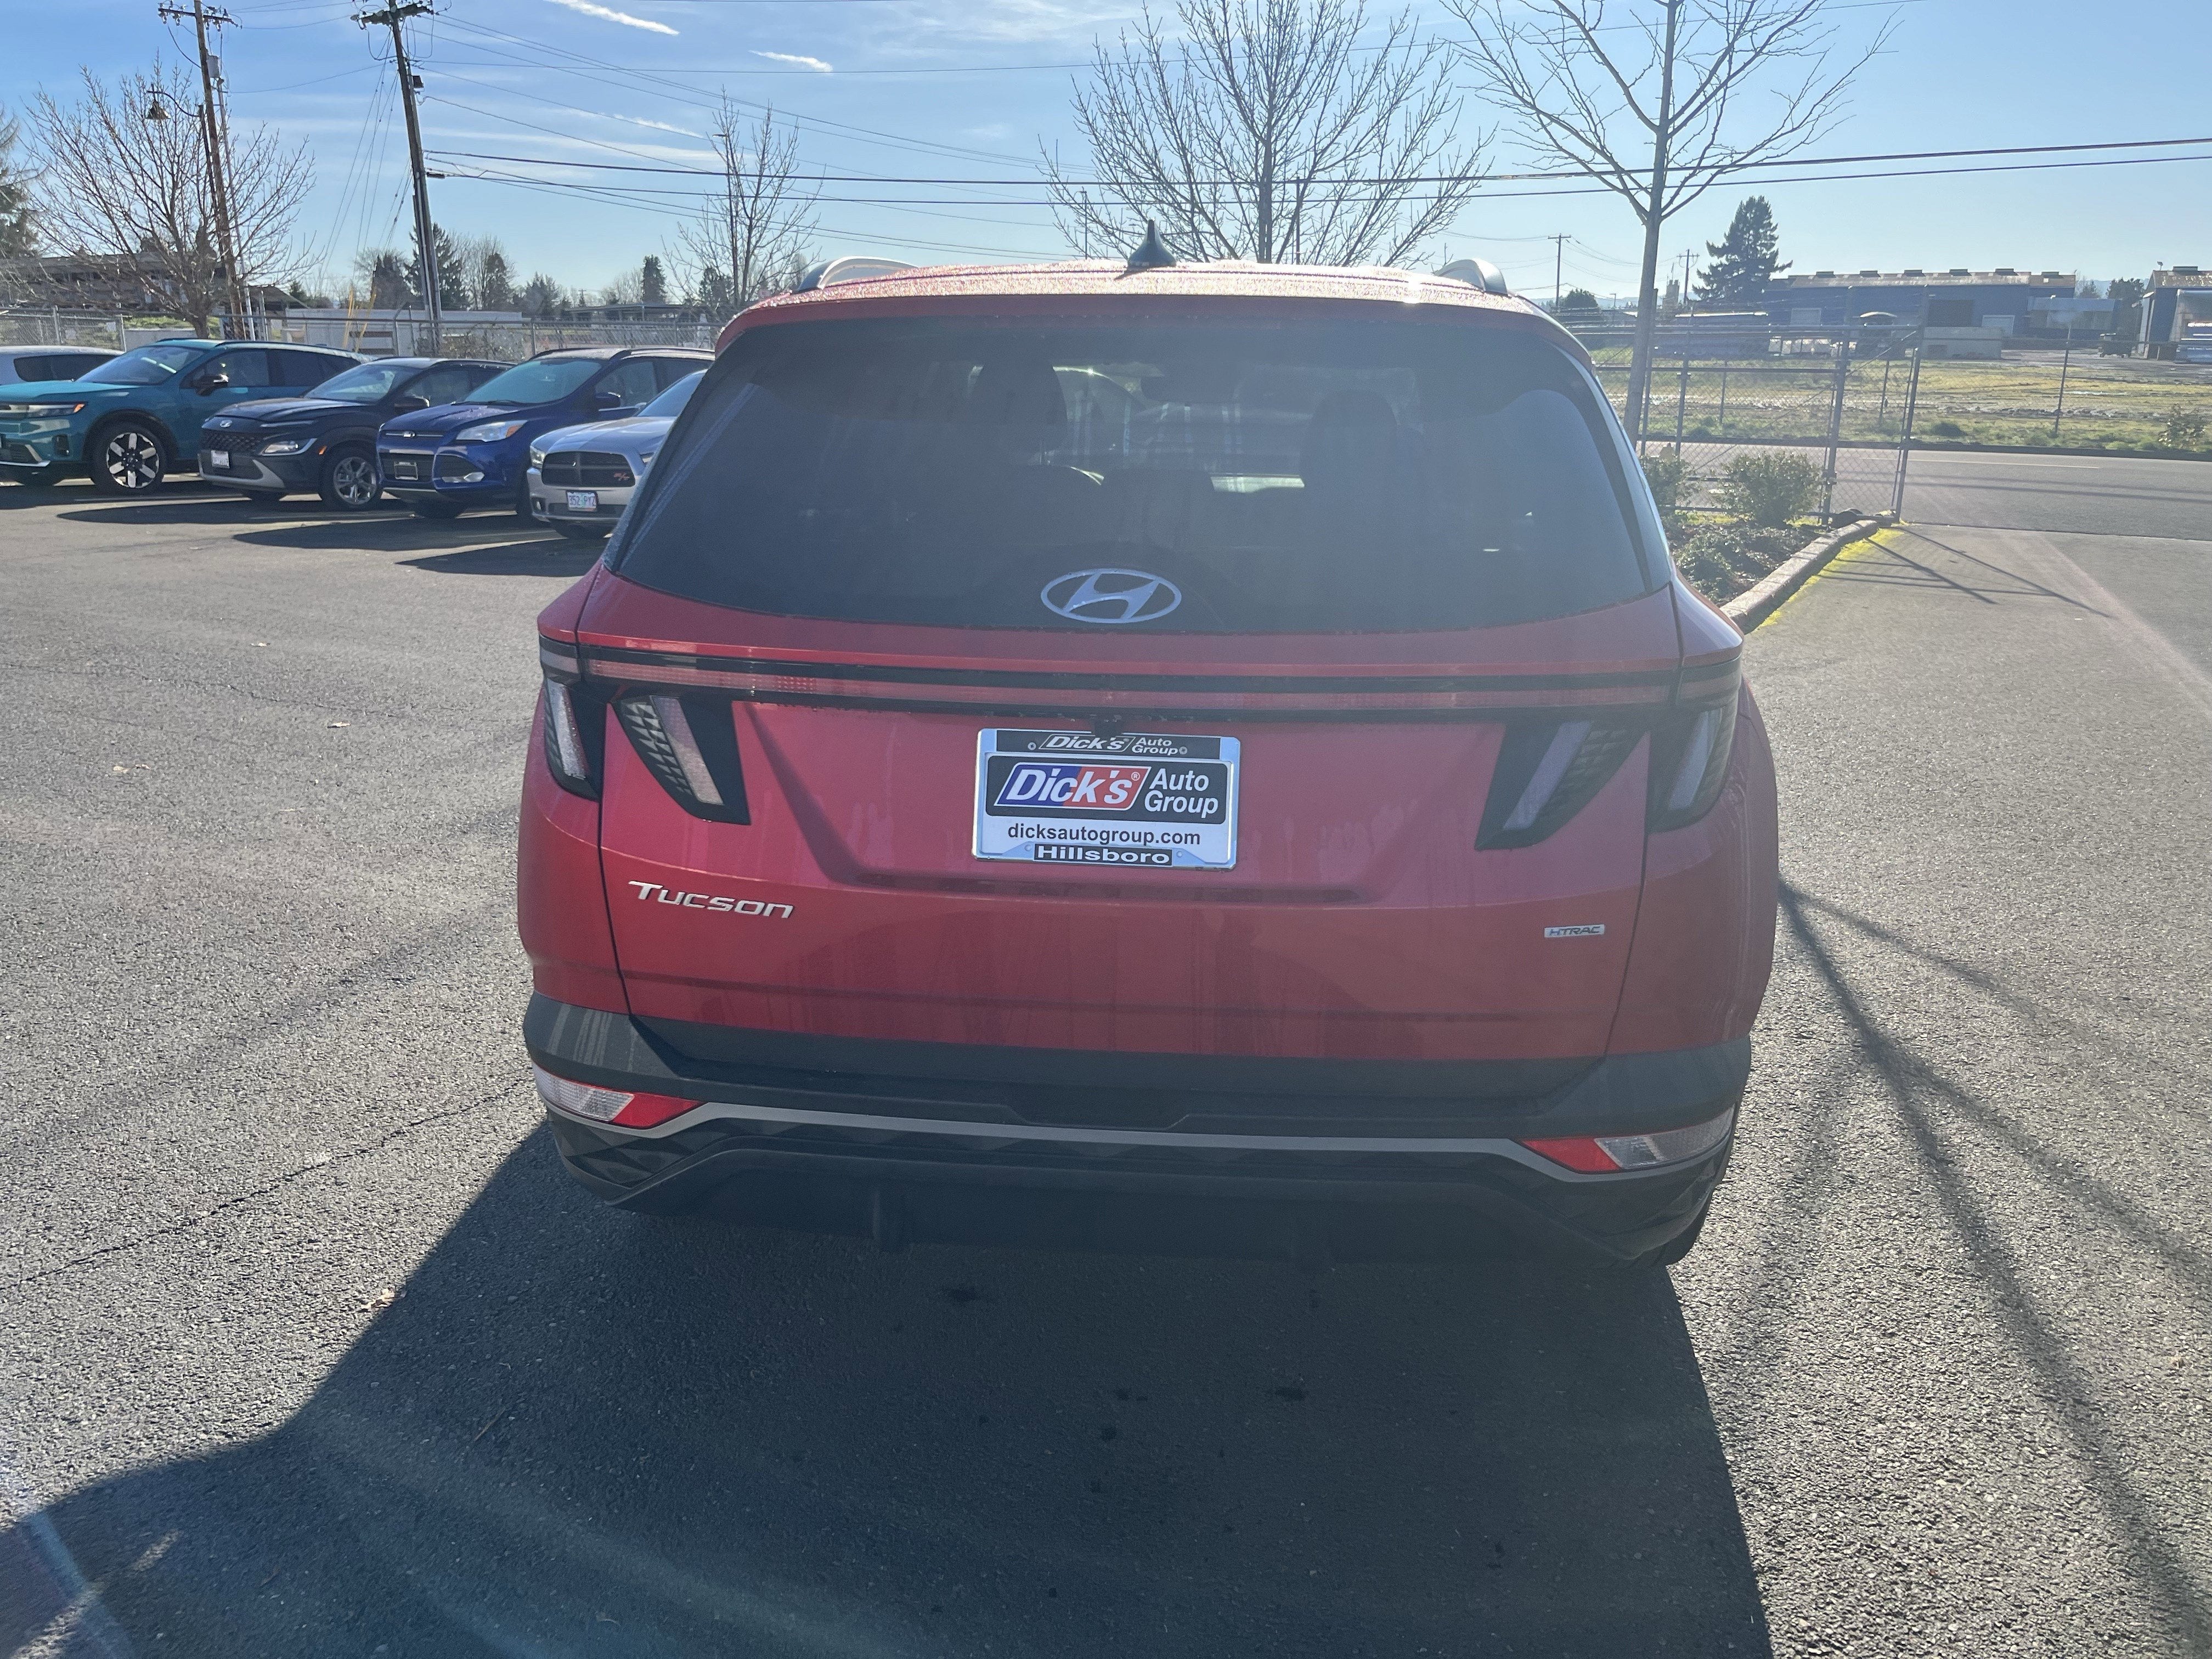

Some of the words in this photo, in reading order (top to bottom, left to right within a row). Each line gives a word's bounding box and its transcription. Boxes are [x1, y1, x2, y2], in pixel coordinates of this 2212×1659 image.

[1046, 736, 1125, 750] Dick's
[1131, 745, 1178, 755] Group
[1136, 737, 1172, 746] Auto
[1006, 768, 1133, 804] Dick's
[1149, 768, 1209, 791] Auto
[1144, 790, 1218, 819] Group
[1008, 823, 1200, 845] dicksautogroup.com
[1037, 845, 1170, 864] Hillsboro
[1549, 926, 1600, 935] HTRAC
